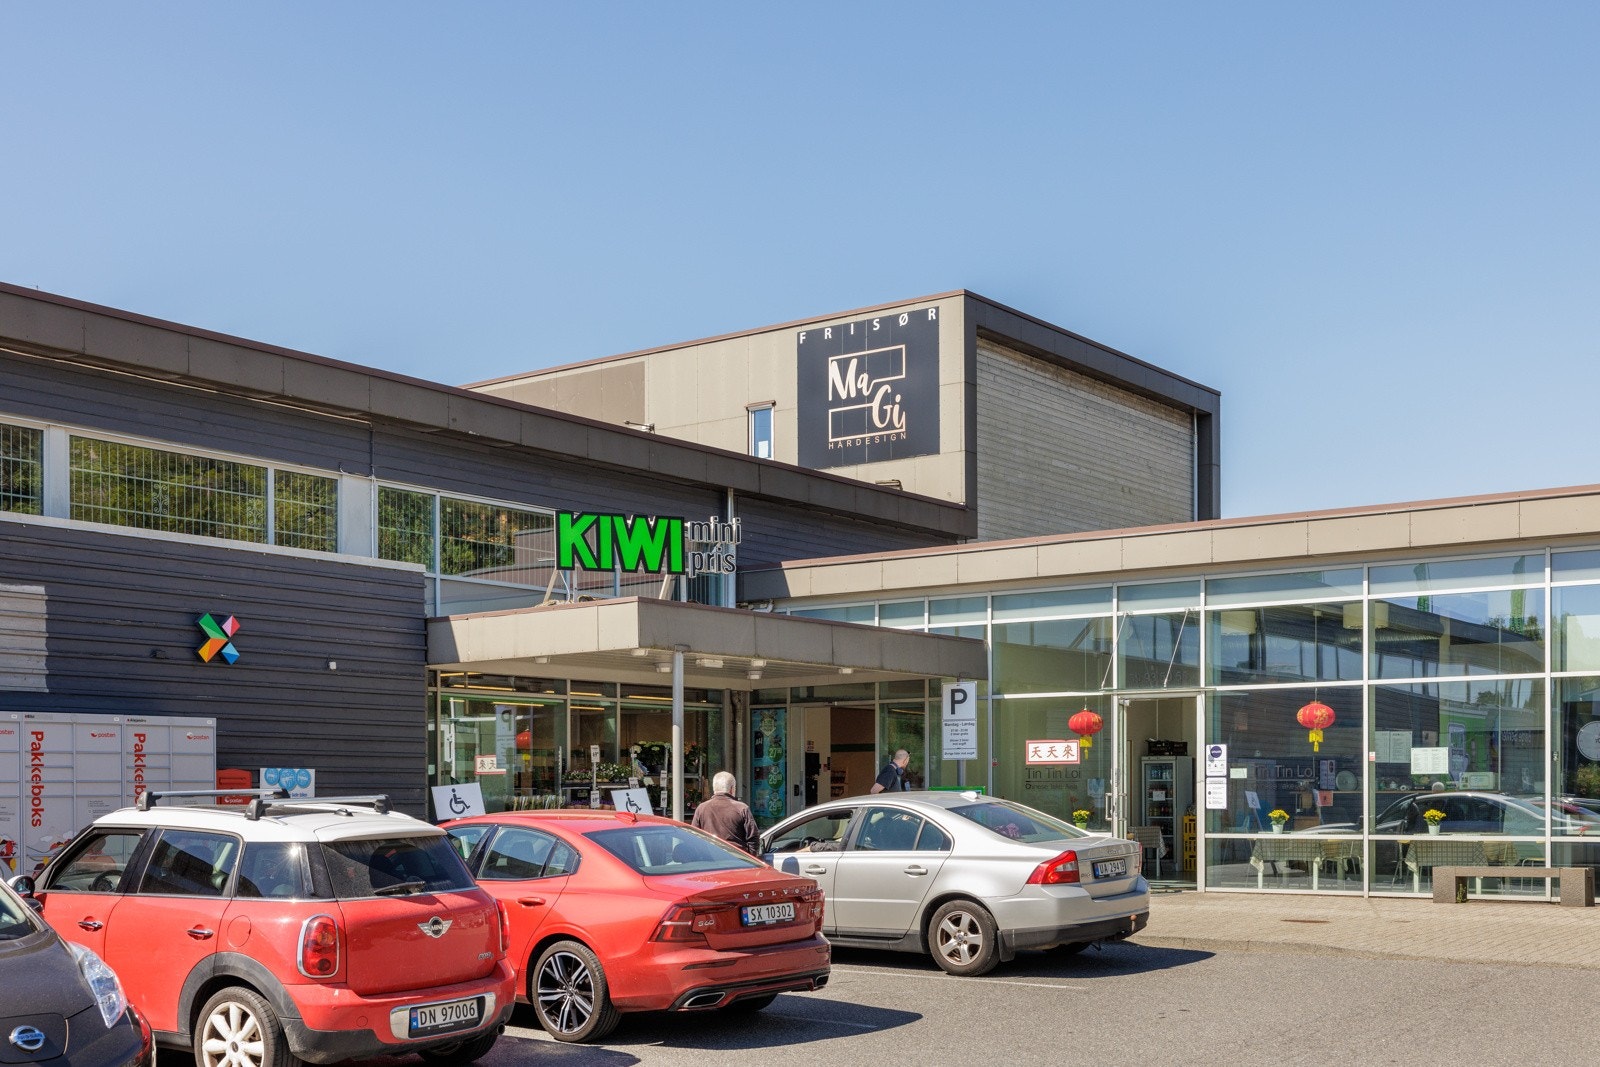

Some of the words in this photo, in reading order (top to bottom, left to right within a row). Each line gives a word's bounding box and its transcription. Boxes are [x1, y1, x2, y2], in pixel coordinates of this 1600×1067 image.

[800, 308, 936, 344] FRISØR
[555, 511, 685, 575] KIWI
[688, 516, 741, 544] mini
[689, 547, 736, 578] pris
[951, 689, 968, 715] P
[1031, 744, 1075, 759] 天天來
[31, 731, 44, 827] Pakkeboks
[134, 733, 147, 805] Pakkeb
[1025, 768, 1042, 779] Tin
[1045, 768, 1062, 779] Tin
[743, 888, 800, 899] VOLVO
[751, 908, 763, 921] SX
[765, 904, 792, 919] 10302
[420, 1010, 436, 1026] DN
[441, 1002, 476, 1022] 97006
